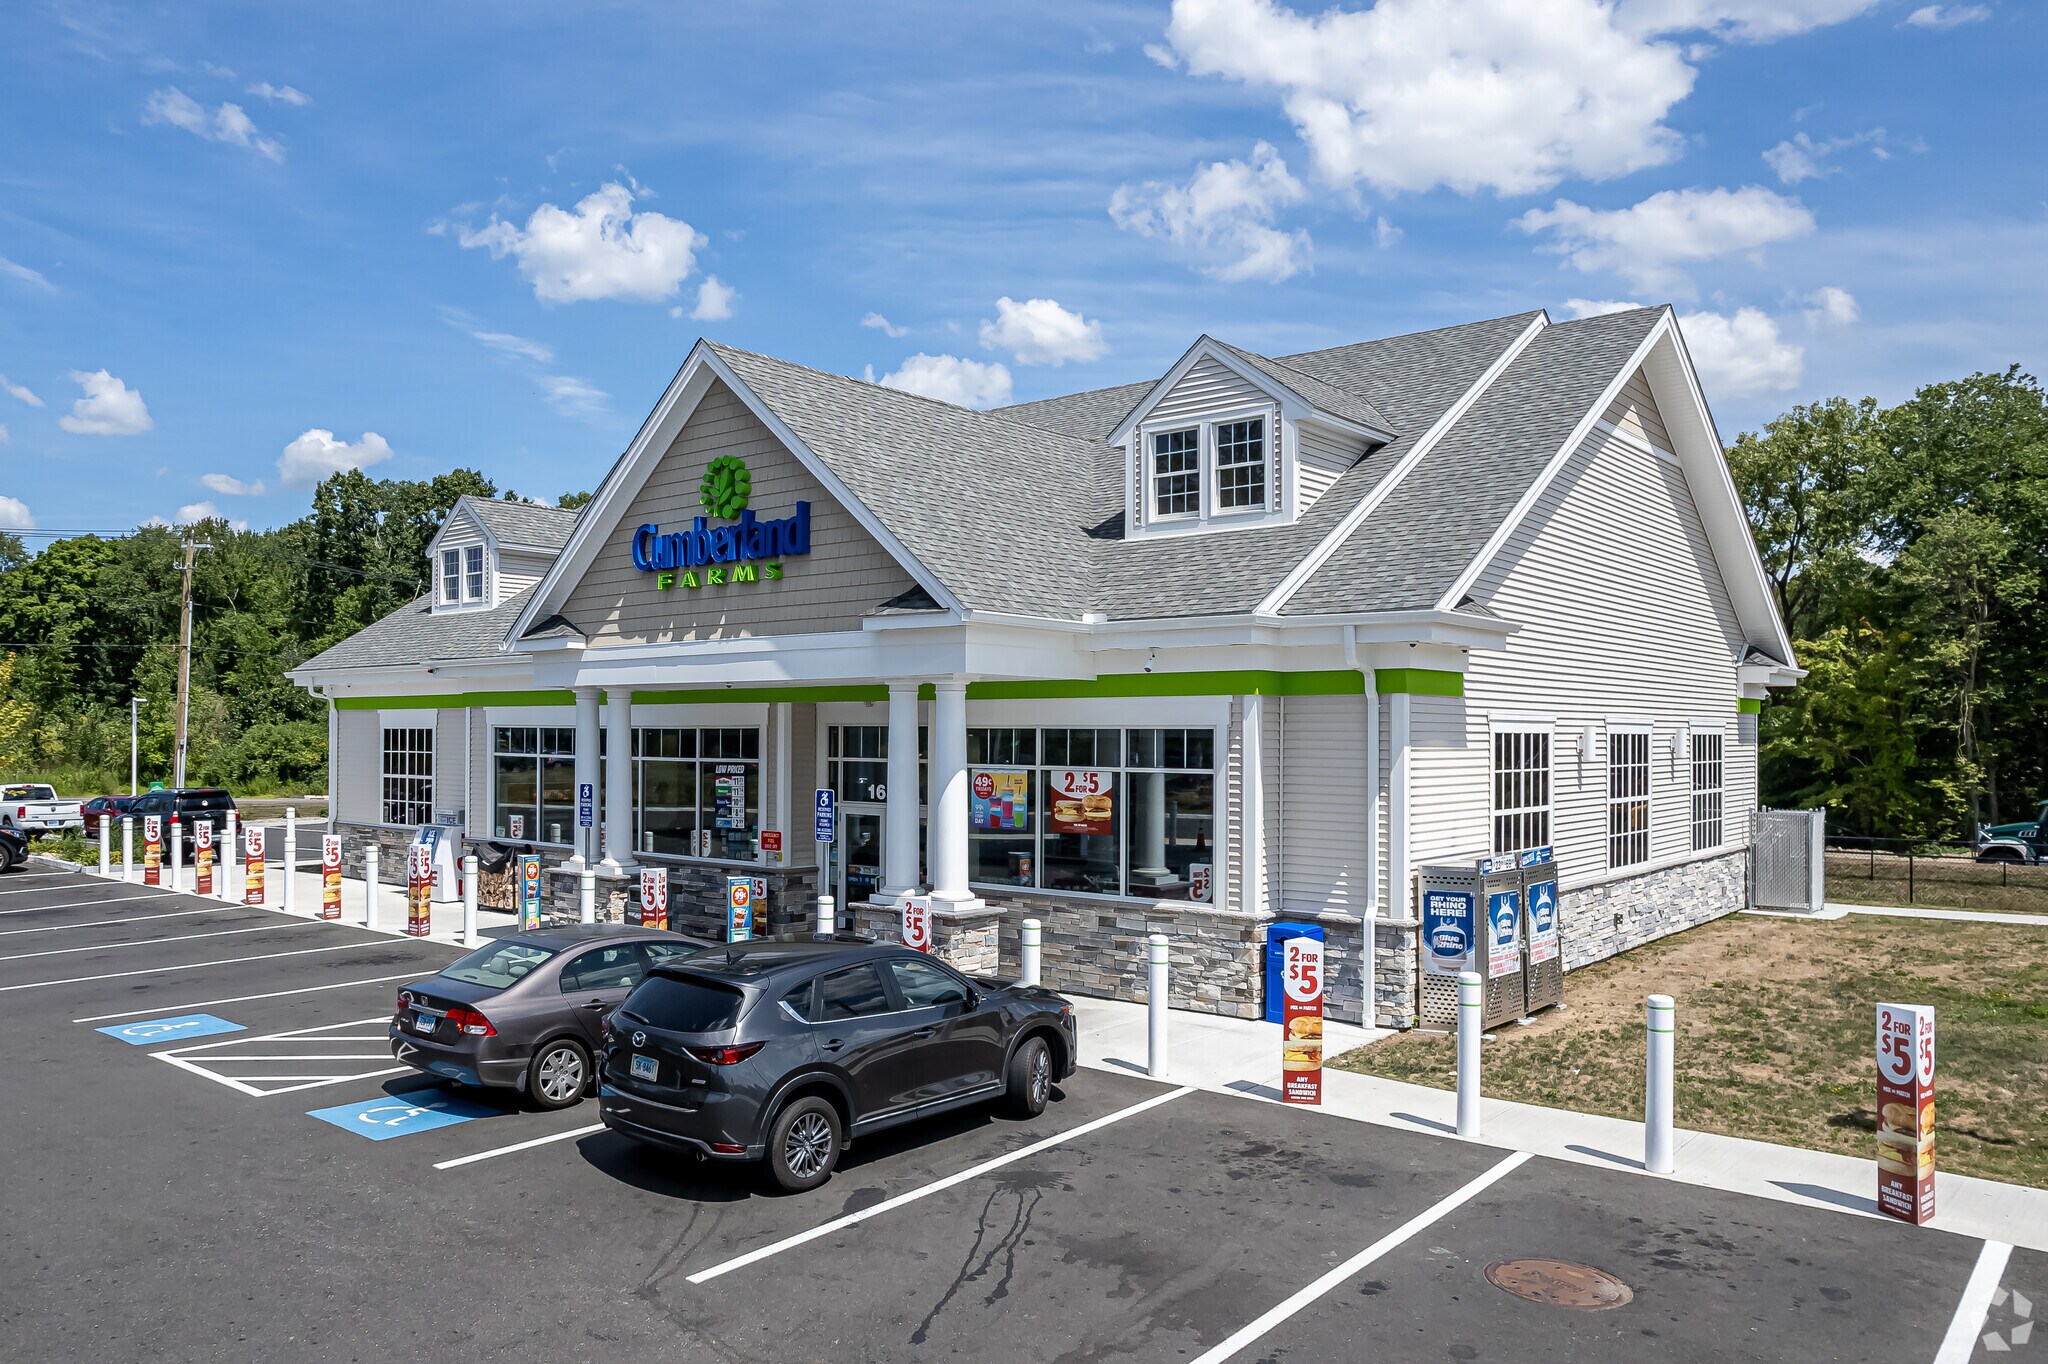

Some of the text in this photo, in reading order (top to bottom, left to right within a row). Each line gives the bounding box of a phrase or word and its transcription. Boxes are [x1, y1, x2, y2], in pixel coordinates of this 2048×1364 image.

[632, 501, 811, 573] Cumberland
[657, 561, 784, 592] FARMS
[715, 765, 745, 774] LOW PRICED
[1064, 771, 1099, 794] 2 FOR $5
[868, 784, 887, 800] 16
[146, 817, 152, 825] 2
[198, 823, 203, 831] 2
[446, 816, 457, 825] ICE
[146, 825, 158, 839] $5
[198, 831, 210, 845] $5
[248, 829, 253, 837] 2
[248, 838, 262, 852] $5
[325, 838, 331, 846] 2
[325, 847, 339, 863] $5
[420, 847, 425, 857] 2
[420, 857, 430, 874] $5
[642, 872, 648, 883] 2
[642, 884, 655, 906] $5
[753, 879, 764, 897] $5
[734, 891, 747, 901] 99¢
[905, 901, 924, 916] 2 FOR
[1430, 901, 1467, 910] RHINO
[1430, 908, 1467, 918] HERE!
[905, 915, 924, 942] $5
[1439, 934, 1460, 943] Blue
[1289, 946, 1319, 963] 2 FOR
[1289, 963, 1318, 995] $5
[1881, 1010, 1911, 1036] 2 FOR
[1919, 1015, 1933, 1037] 2 FOR
[1881, 1032, 1912, 1076] $5
[1919, 1037, 1932, 1076] $5
[1286, 1082, 1318, 1090] BREAKFAST
[1288, 1089, 1317, 1097] SANDWICH
[1890, 1180, 1903, 1190] ANY
[1881, 1184, 1913, 1203] BREAKFAST
[1882, 1194, 1912, 1211] SANDWICH
